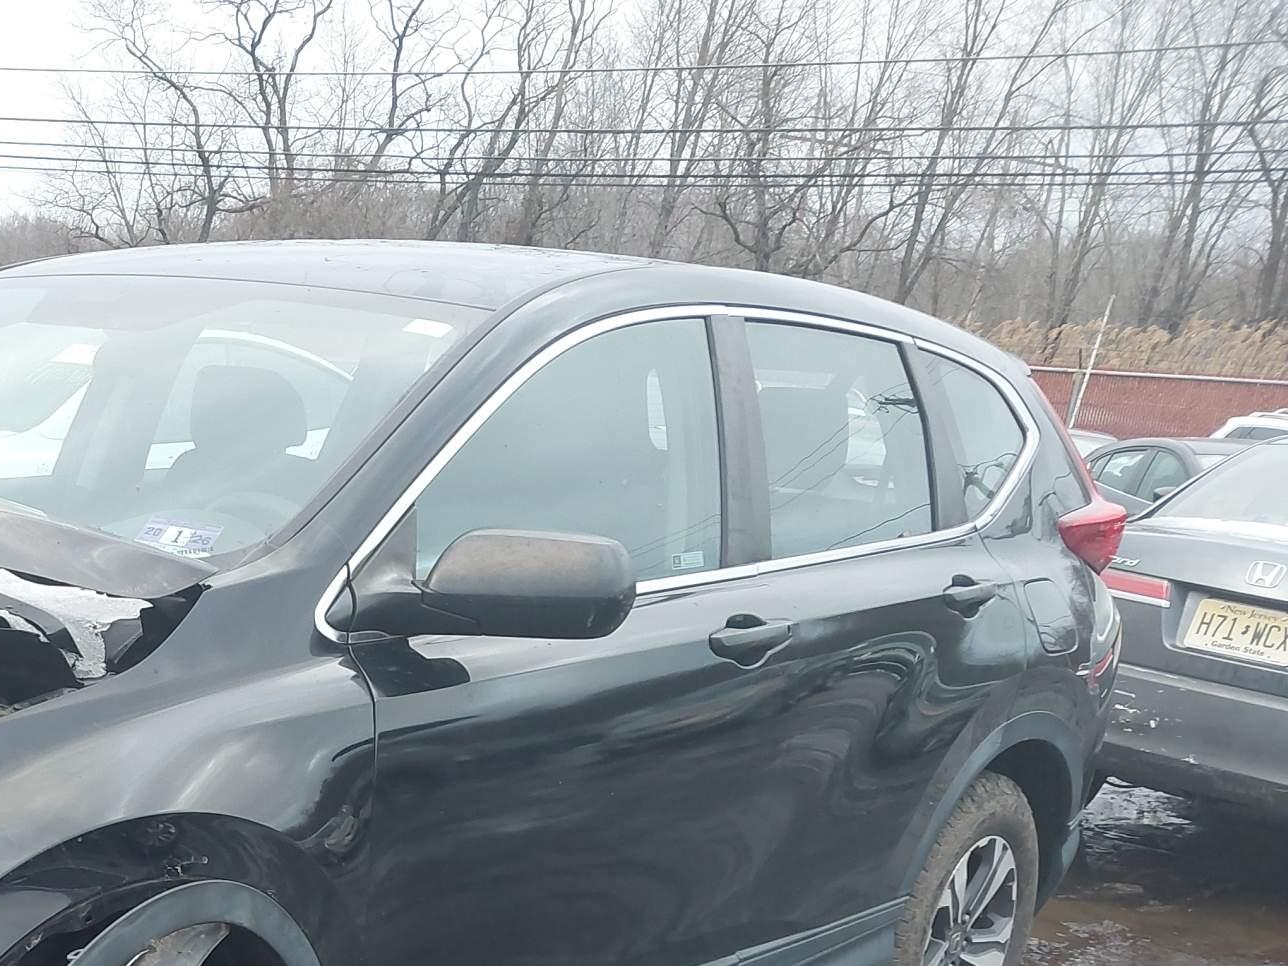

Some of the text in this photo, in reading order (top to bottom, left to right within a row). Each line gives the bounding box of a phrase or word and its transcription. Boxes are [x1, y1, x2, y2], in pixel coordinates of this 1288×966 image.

[1225, 605, 1278, 622] New Jersey
[1196, 612, 1238, 641] H71
[1211, 640, 1265, 656] Garden State
